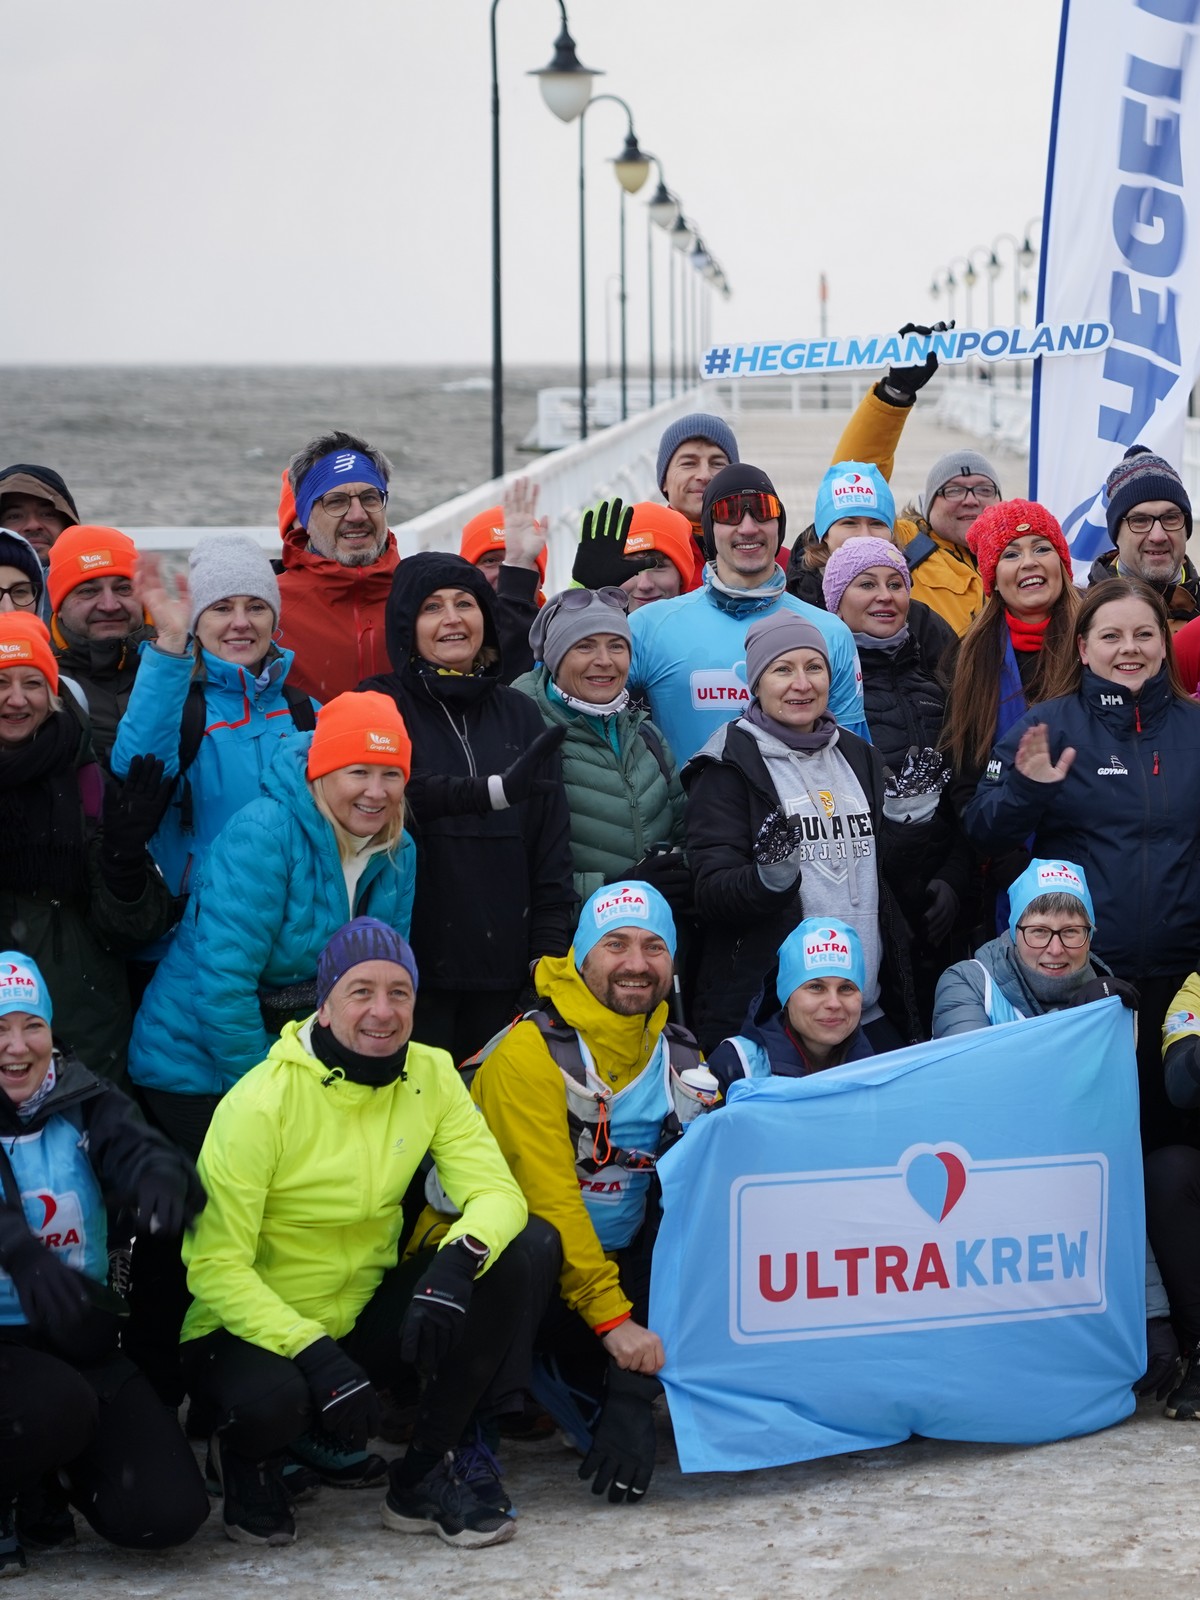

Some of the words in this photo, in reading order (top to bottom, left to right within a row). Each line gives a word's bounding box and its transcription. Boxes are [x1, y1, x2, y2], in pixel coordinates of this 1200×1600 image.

[703, 322, 1110, 375] #HEGELMANNPOLAND
[835, 486, 874, 496] ULTRA
[697, 687, 750, 701] ULTRA
[1100, 694, 1124, 706] HH
[1097, 767, 1128, 776] GDYNIA
[801, 844, 815, 861] BY
[1041, 871, 1081, 883] ULTRA
[597, 896, 645, 913] ULTRA
[807, 943, 848, 955] ULTRA
[0, 987, 34, 999] REW
